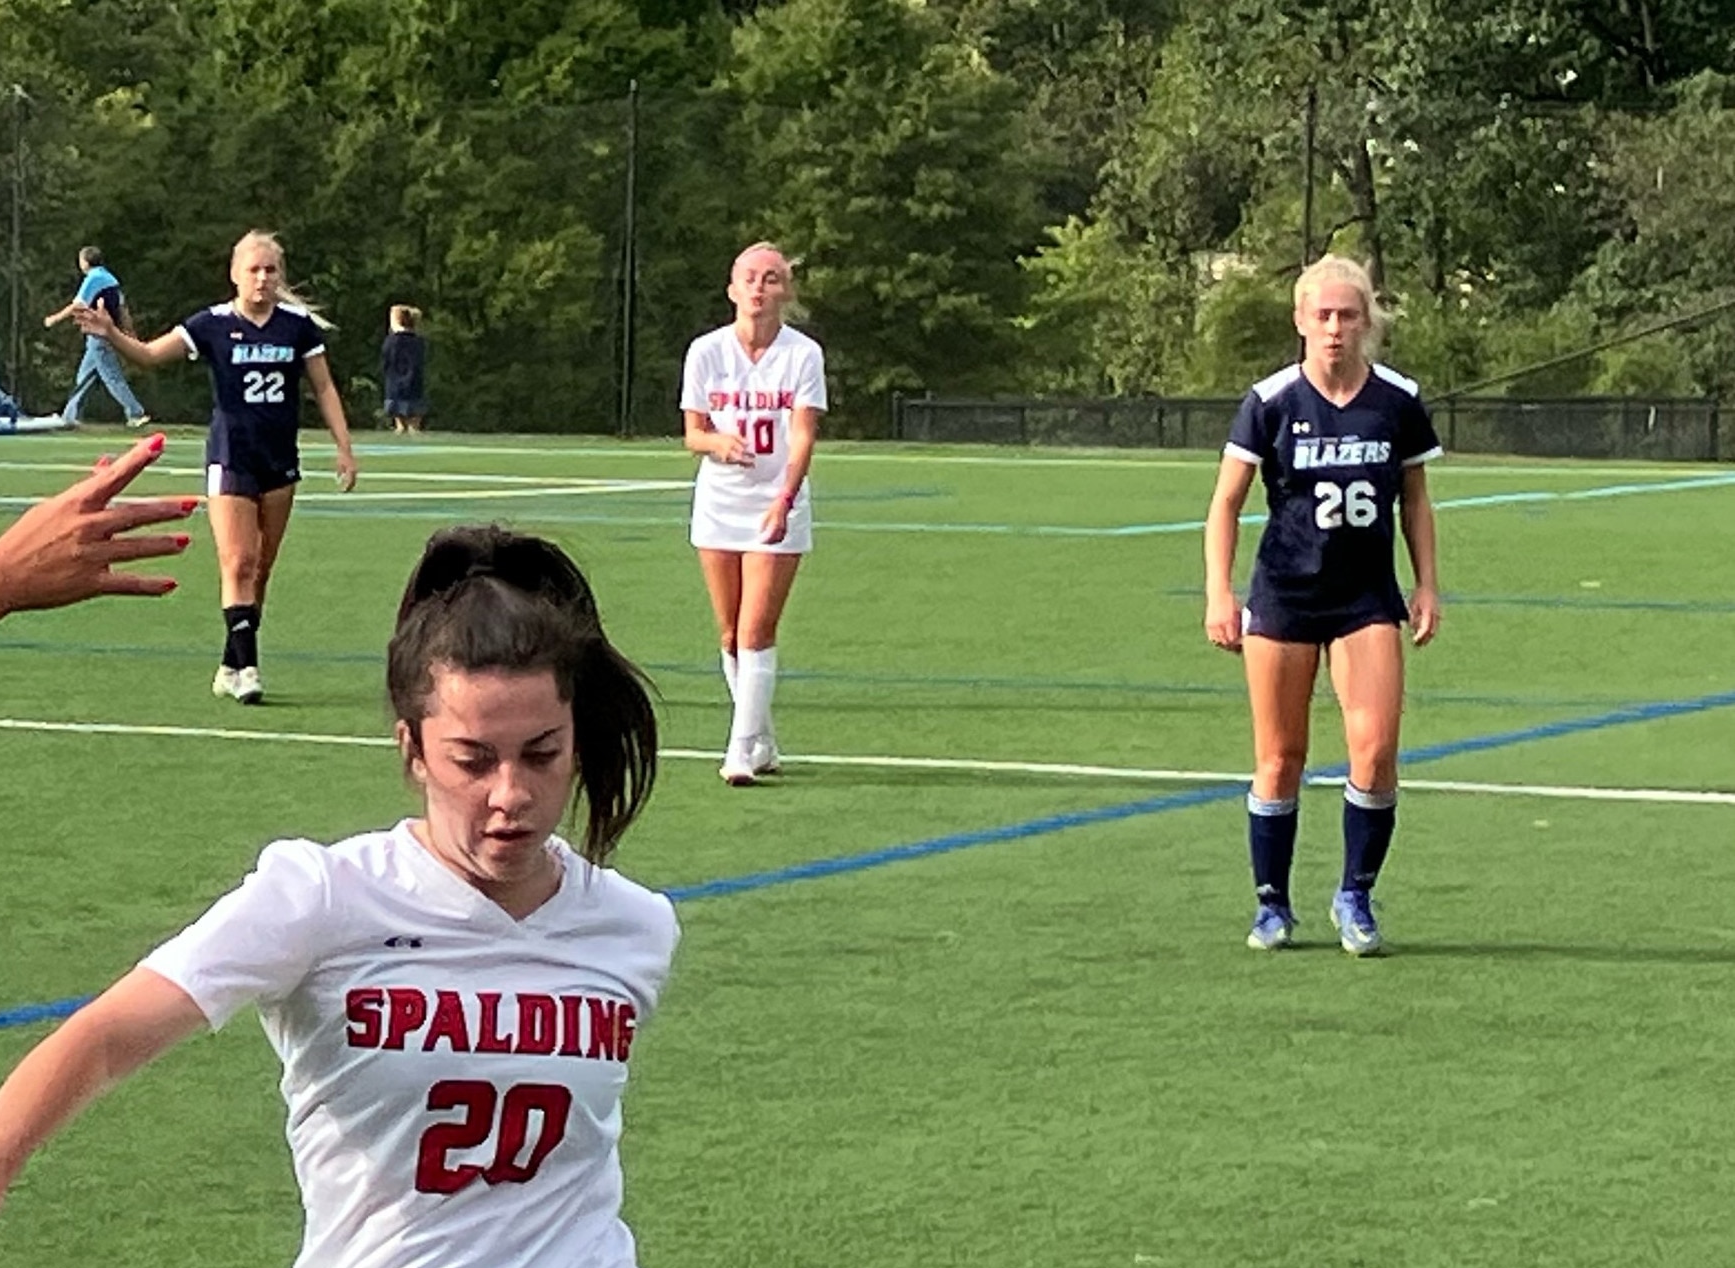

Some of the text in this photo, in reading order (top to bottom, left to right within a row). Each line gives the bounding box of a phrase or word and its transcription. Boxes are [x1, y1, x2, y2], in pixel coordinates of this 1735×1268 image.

[243, 371, 285, 403] 22
[1293, 441, 1392, 469] BLAZERS
[1314, 480, 1378, 530] 26
[345, 985, 637, 1063] SPALDING
[415, 1080, 573, 1194] 20
